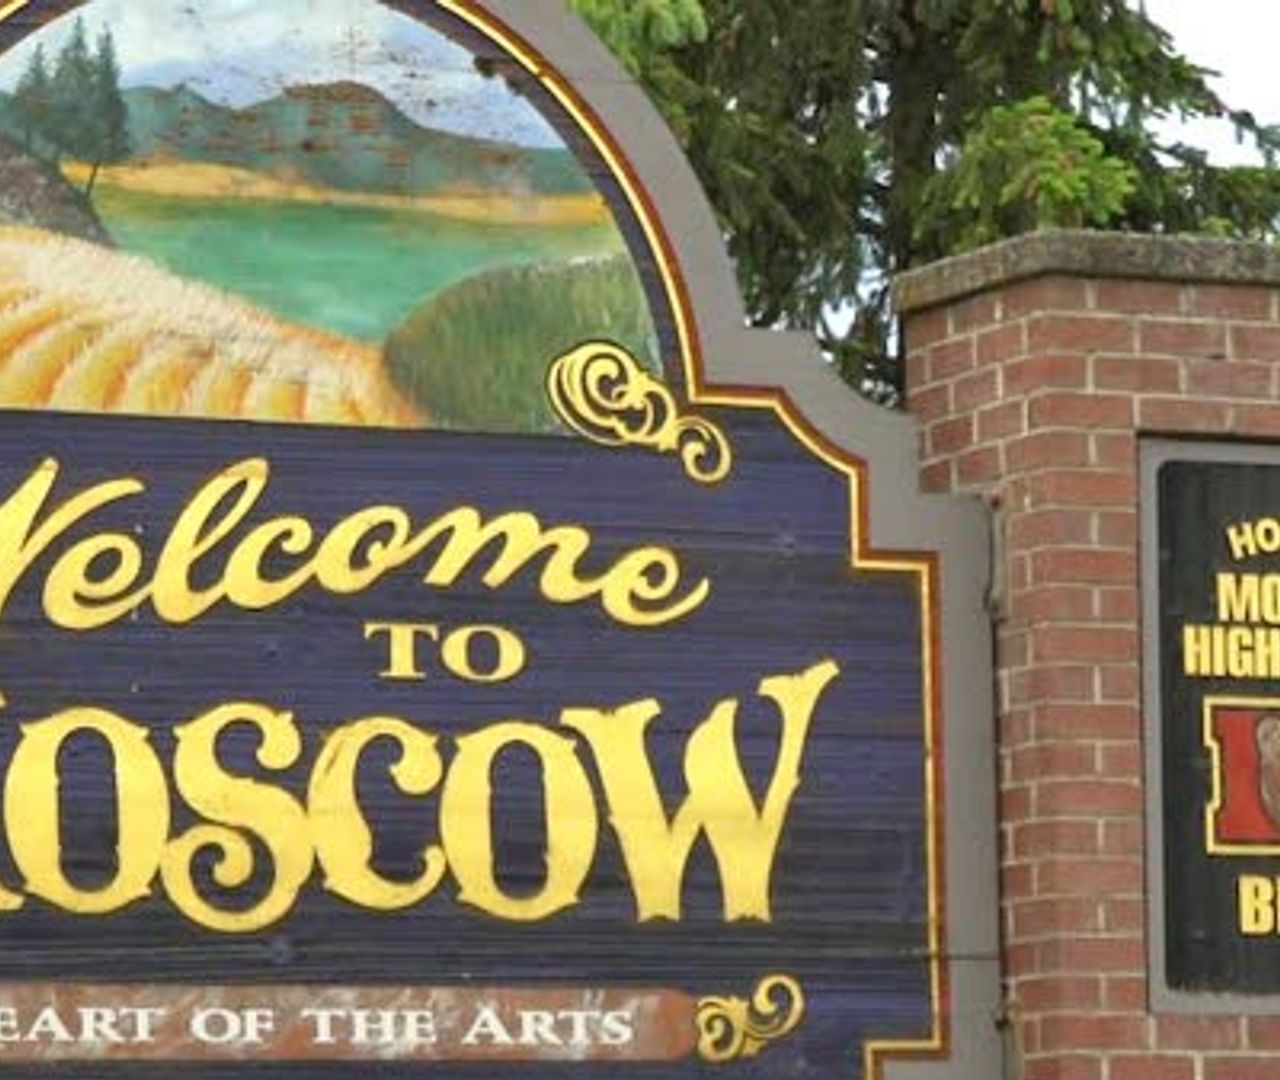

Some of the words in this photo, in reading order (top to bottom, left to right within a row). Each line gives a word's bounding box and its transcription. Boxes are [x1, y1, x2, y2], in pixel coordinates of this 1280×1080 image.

[364, 621, 525, 682] TO
[188, 1007, 275, 1043] OF
[301, 1007, 437, 1046] THE
[461, 1005, 634, 1047] ARTS
